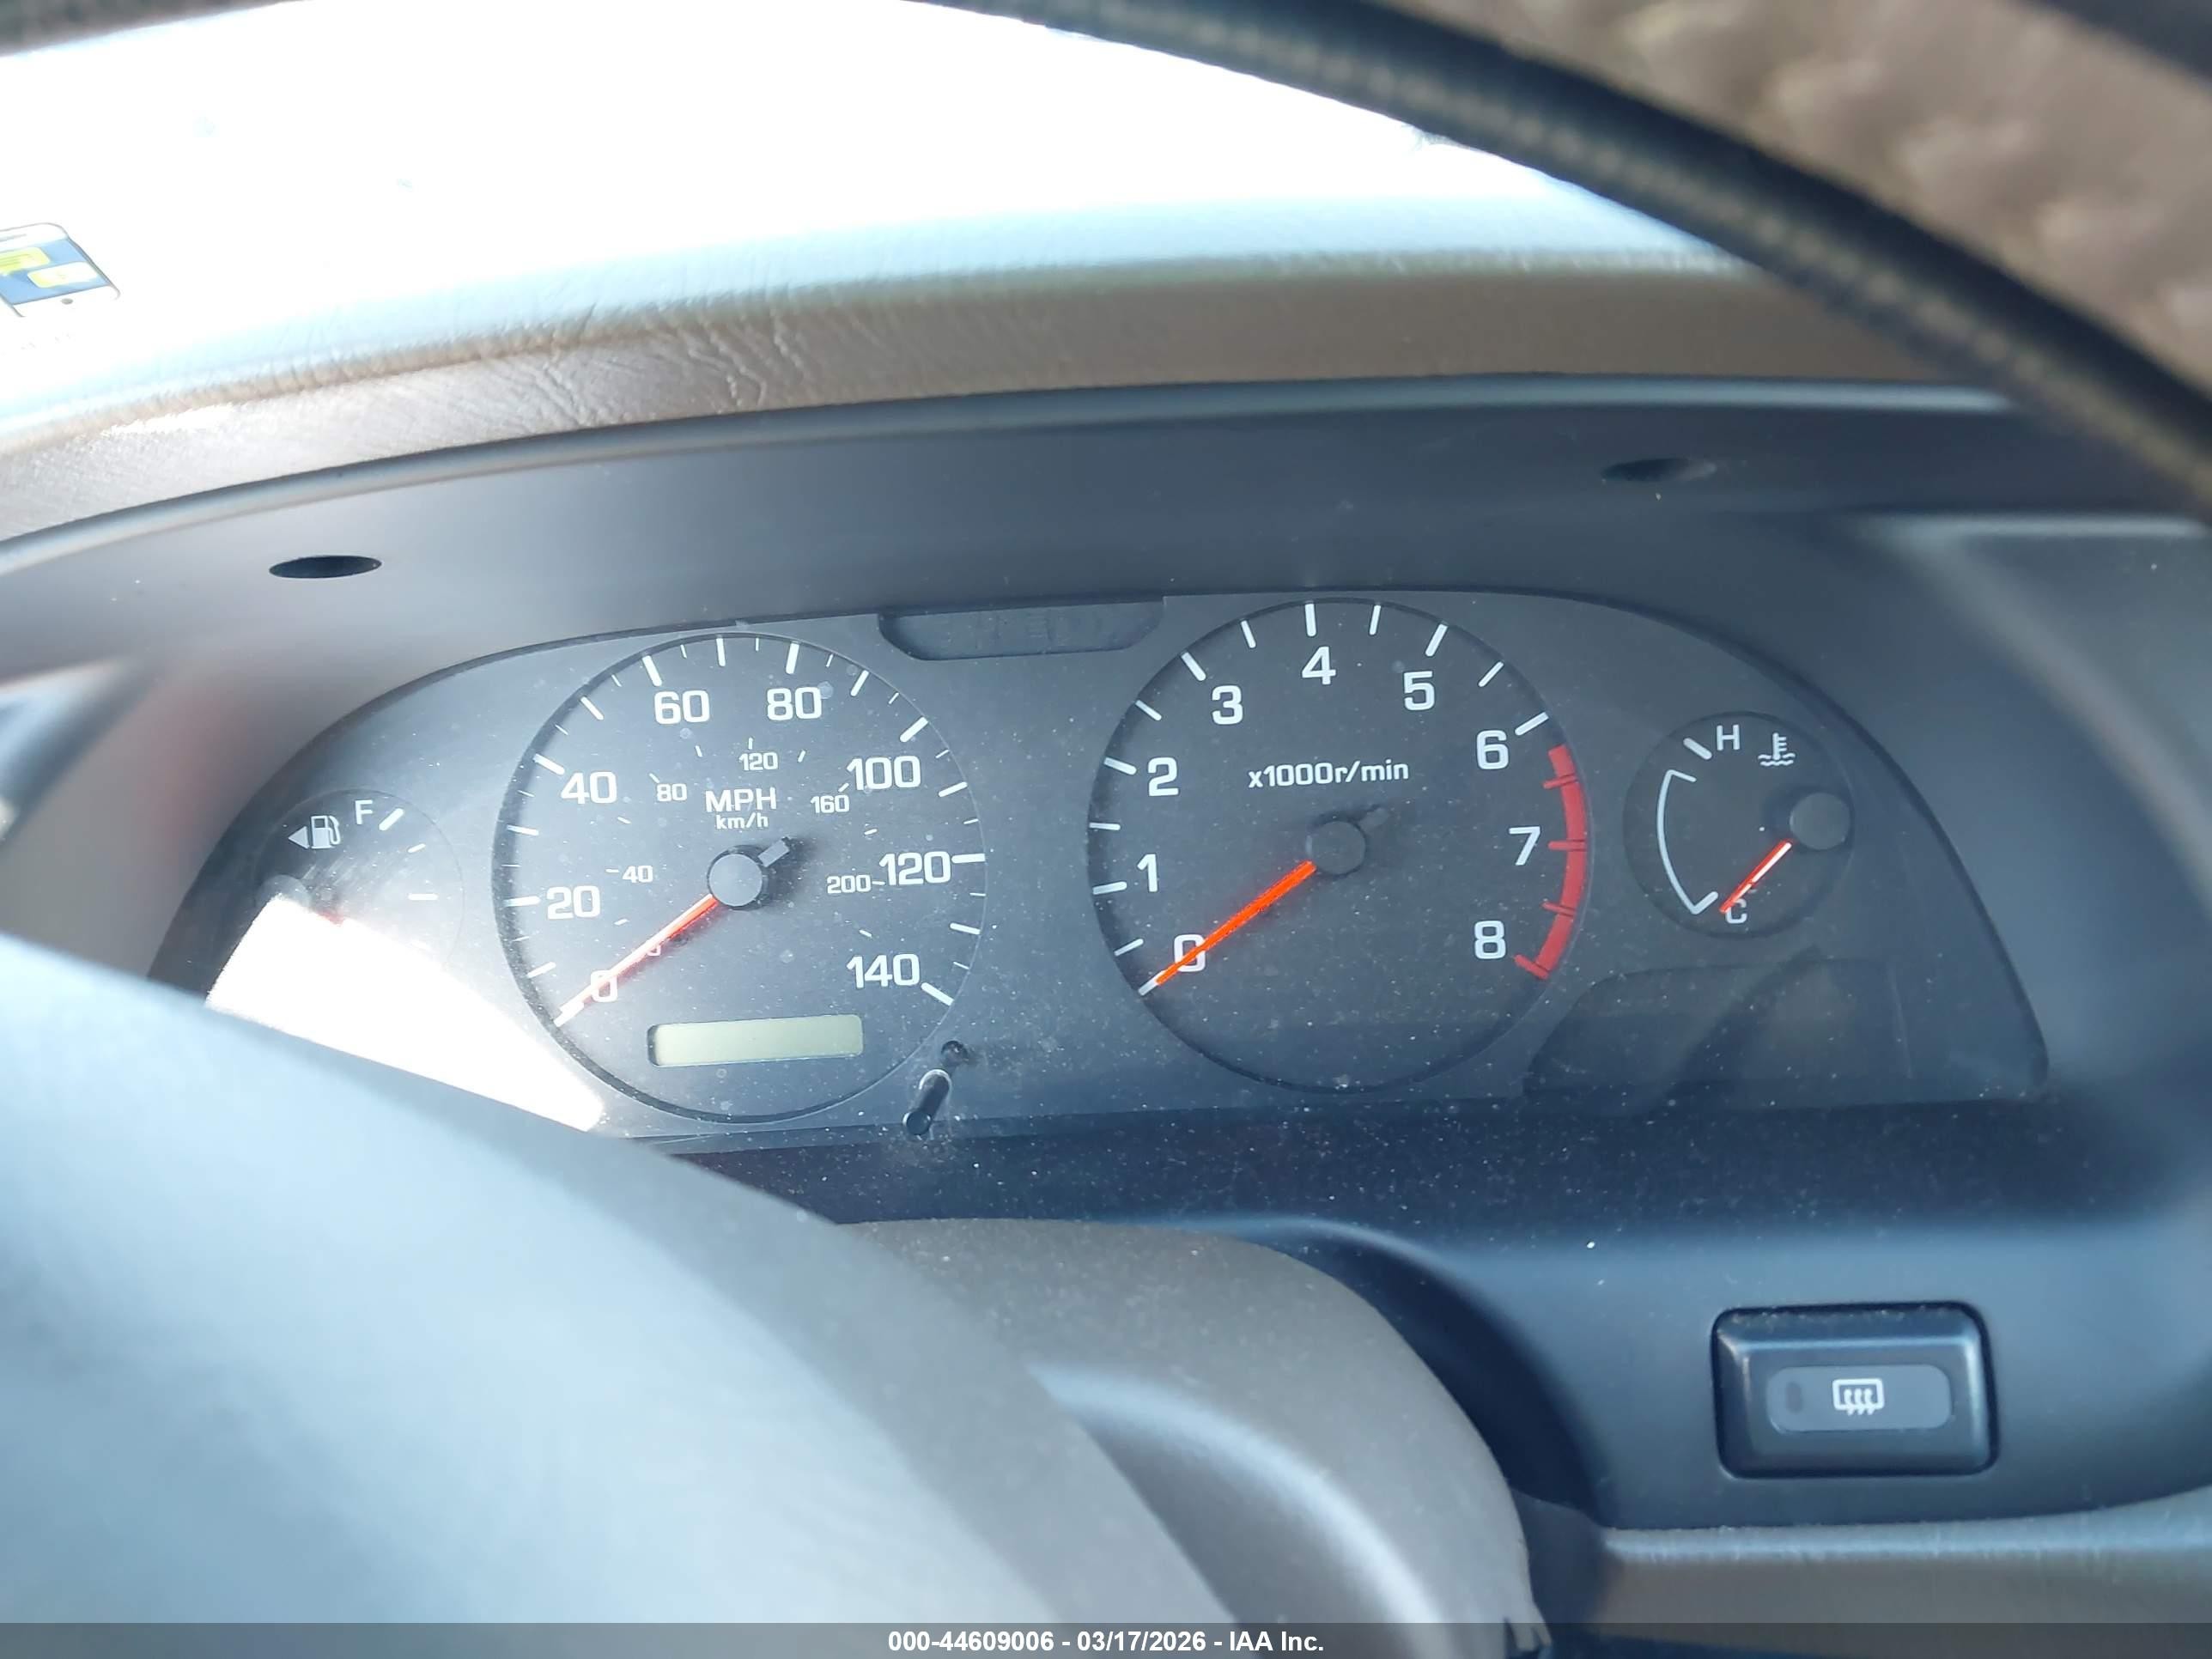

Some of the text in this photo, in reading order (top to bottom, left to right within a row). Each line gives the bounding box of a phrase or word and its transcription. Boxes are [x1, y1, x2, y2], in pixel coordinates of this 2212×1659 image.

[1302, 647, 1336, 685] 4
[654, 690, 710, 724] 60
[767, 687, 822, 720] 80
[1212, 685, 1243, 724] 3
[1403, 671, 1435, 710] 5
[1476, 730, 1509, 769] 6
[1717, 725, 1740, 750] H
[739, 752, 778, 770] 120
[847, 756, 921, 791] 100
[1148, 757, 1178, 796] 2
[1248, 760, 1409, 788] x1000r/min
[561, 771, 617, 804] 40
[657, 783, 687, 802] 80
[705, 788, 776, 812] MPH
[811, 794, 849, 812] 160
[355, 799, 373, 824] F
[715, 812, 769, 830] km/h
[1508, 826, 1540, 866] 7
[622, 866, 653, 883] 40
[827, 875, 871, 893] 200
[879, 852, 951, 885] 120
[1137, 854, 1158, 892] 1
[546, 885, 600, 919] 20
[1725, 898, 1747, 924] C
[1174, 934, 1206, 972] 0
[1474, 920, 1506, 959] 8
[591, 969, 617, 1002] 0
[846, 954, 921, 988] 140
